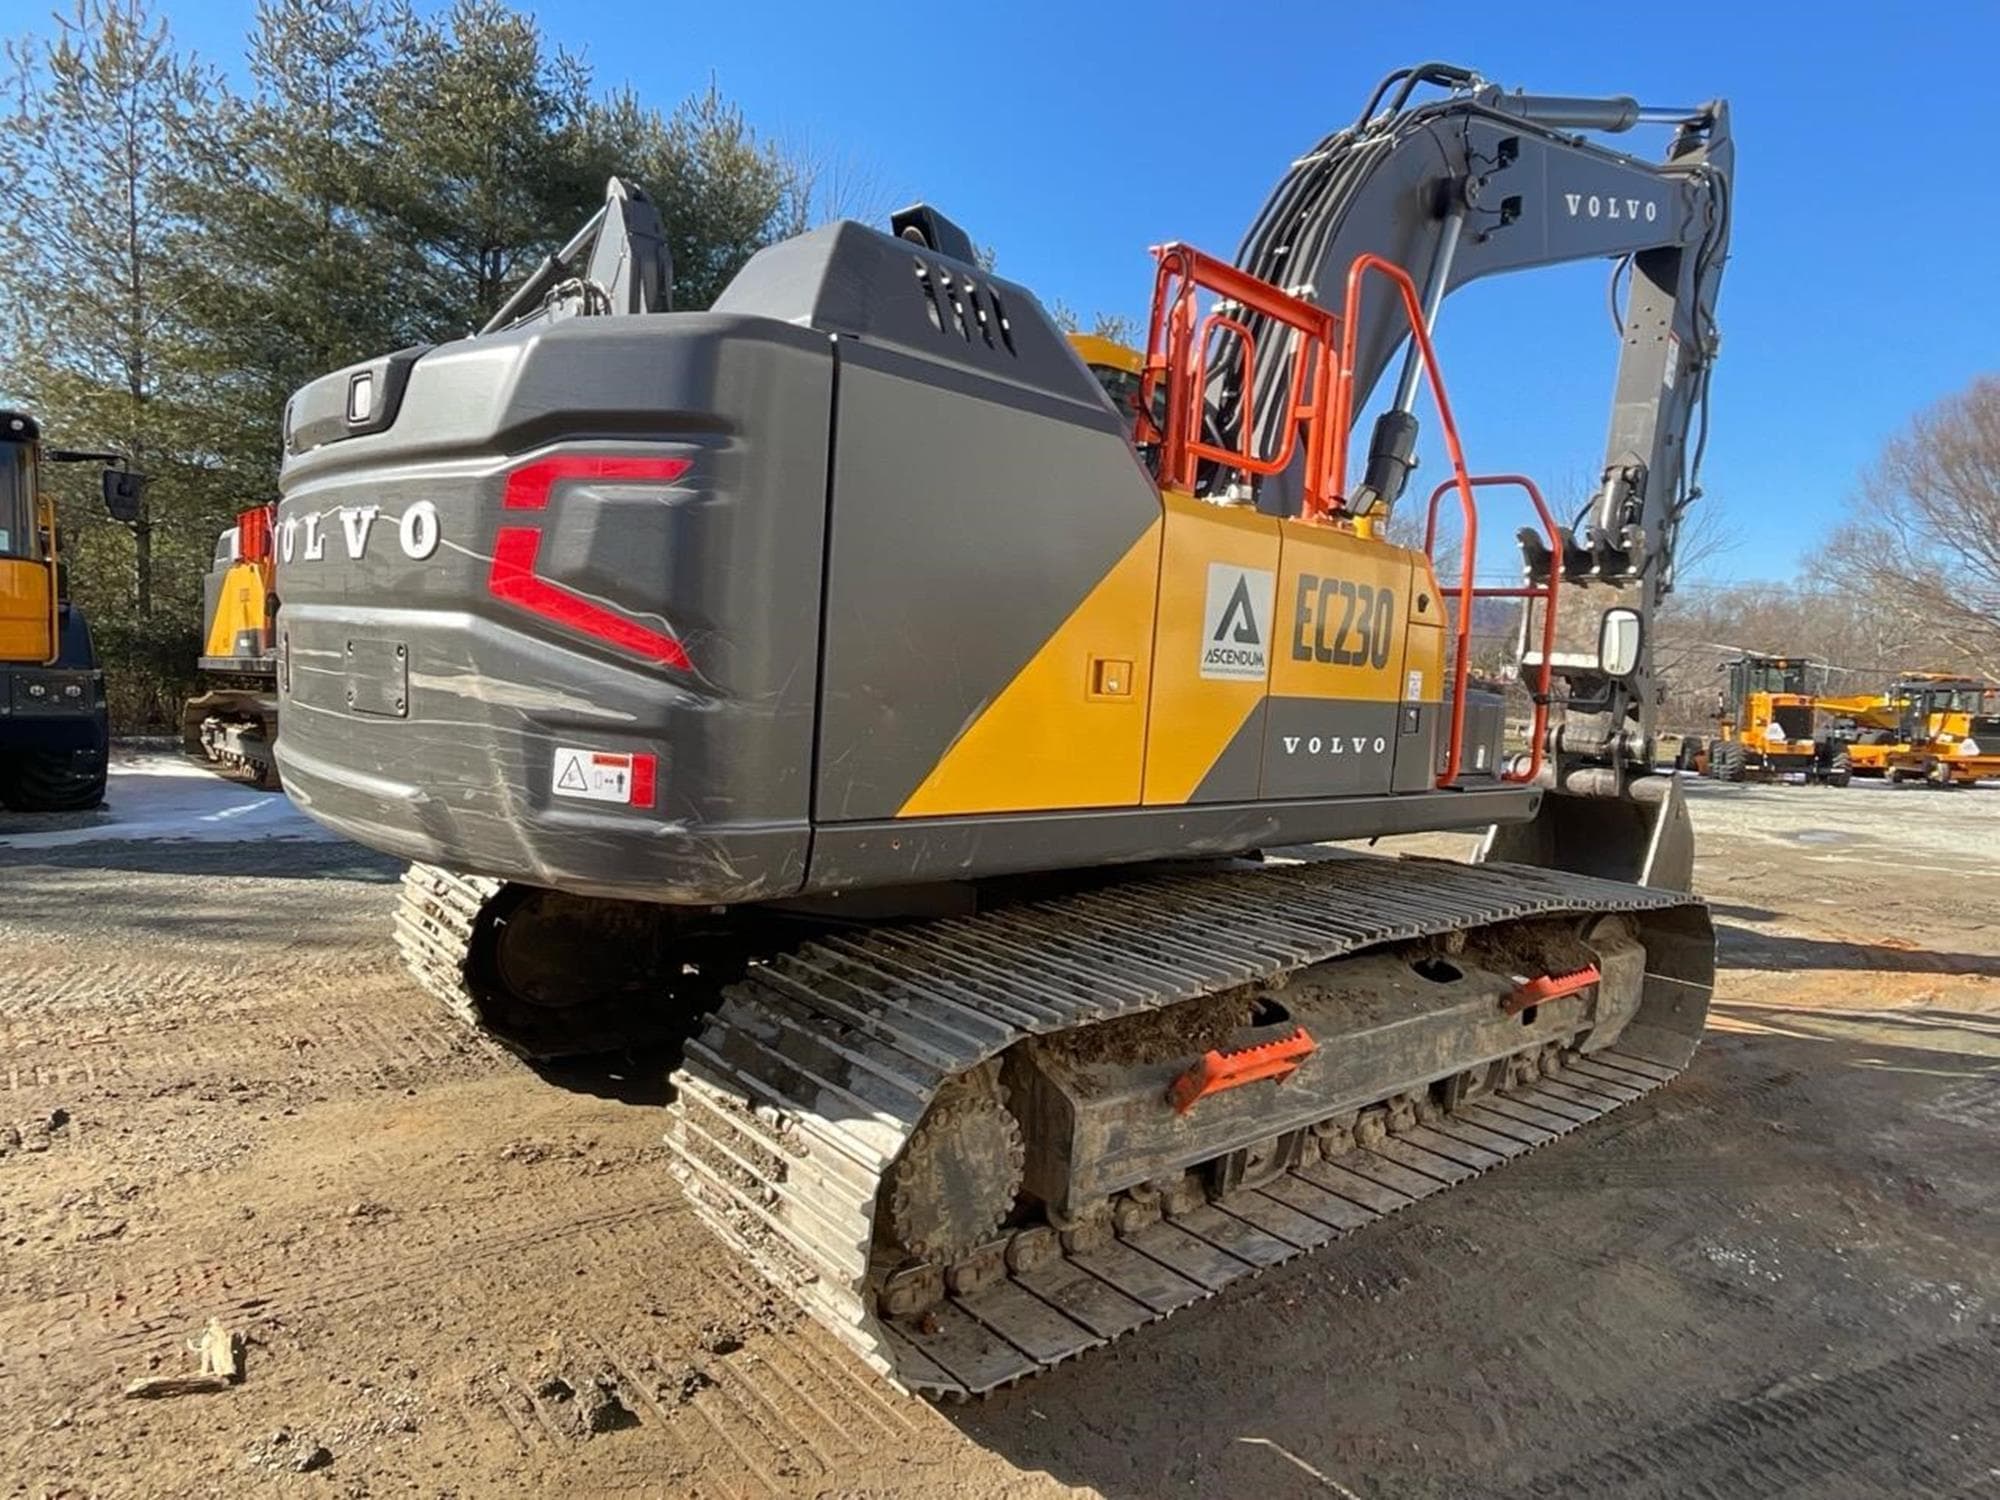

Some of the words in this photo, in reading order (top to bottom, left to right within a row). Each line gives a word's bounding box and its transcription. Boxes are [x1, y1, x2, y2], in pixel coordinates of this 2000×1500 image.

[1564, 193, 1657, 222] VOLVO
[1292, 573, 1395, 670] EC230
[1203, 648, 1265, 667] ASCENDUM
[1283, 736, 1386, 754] VOLVO
